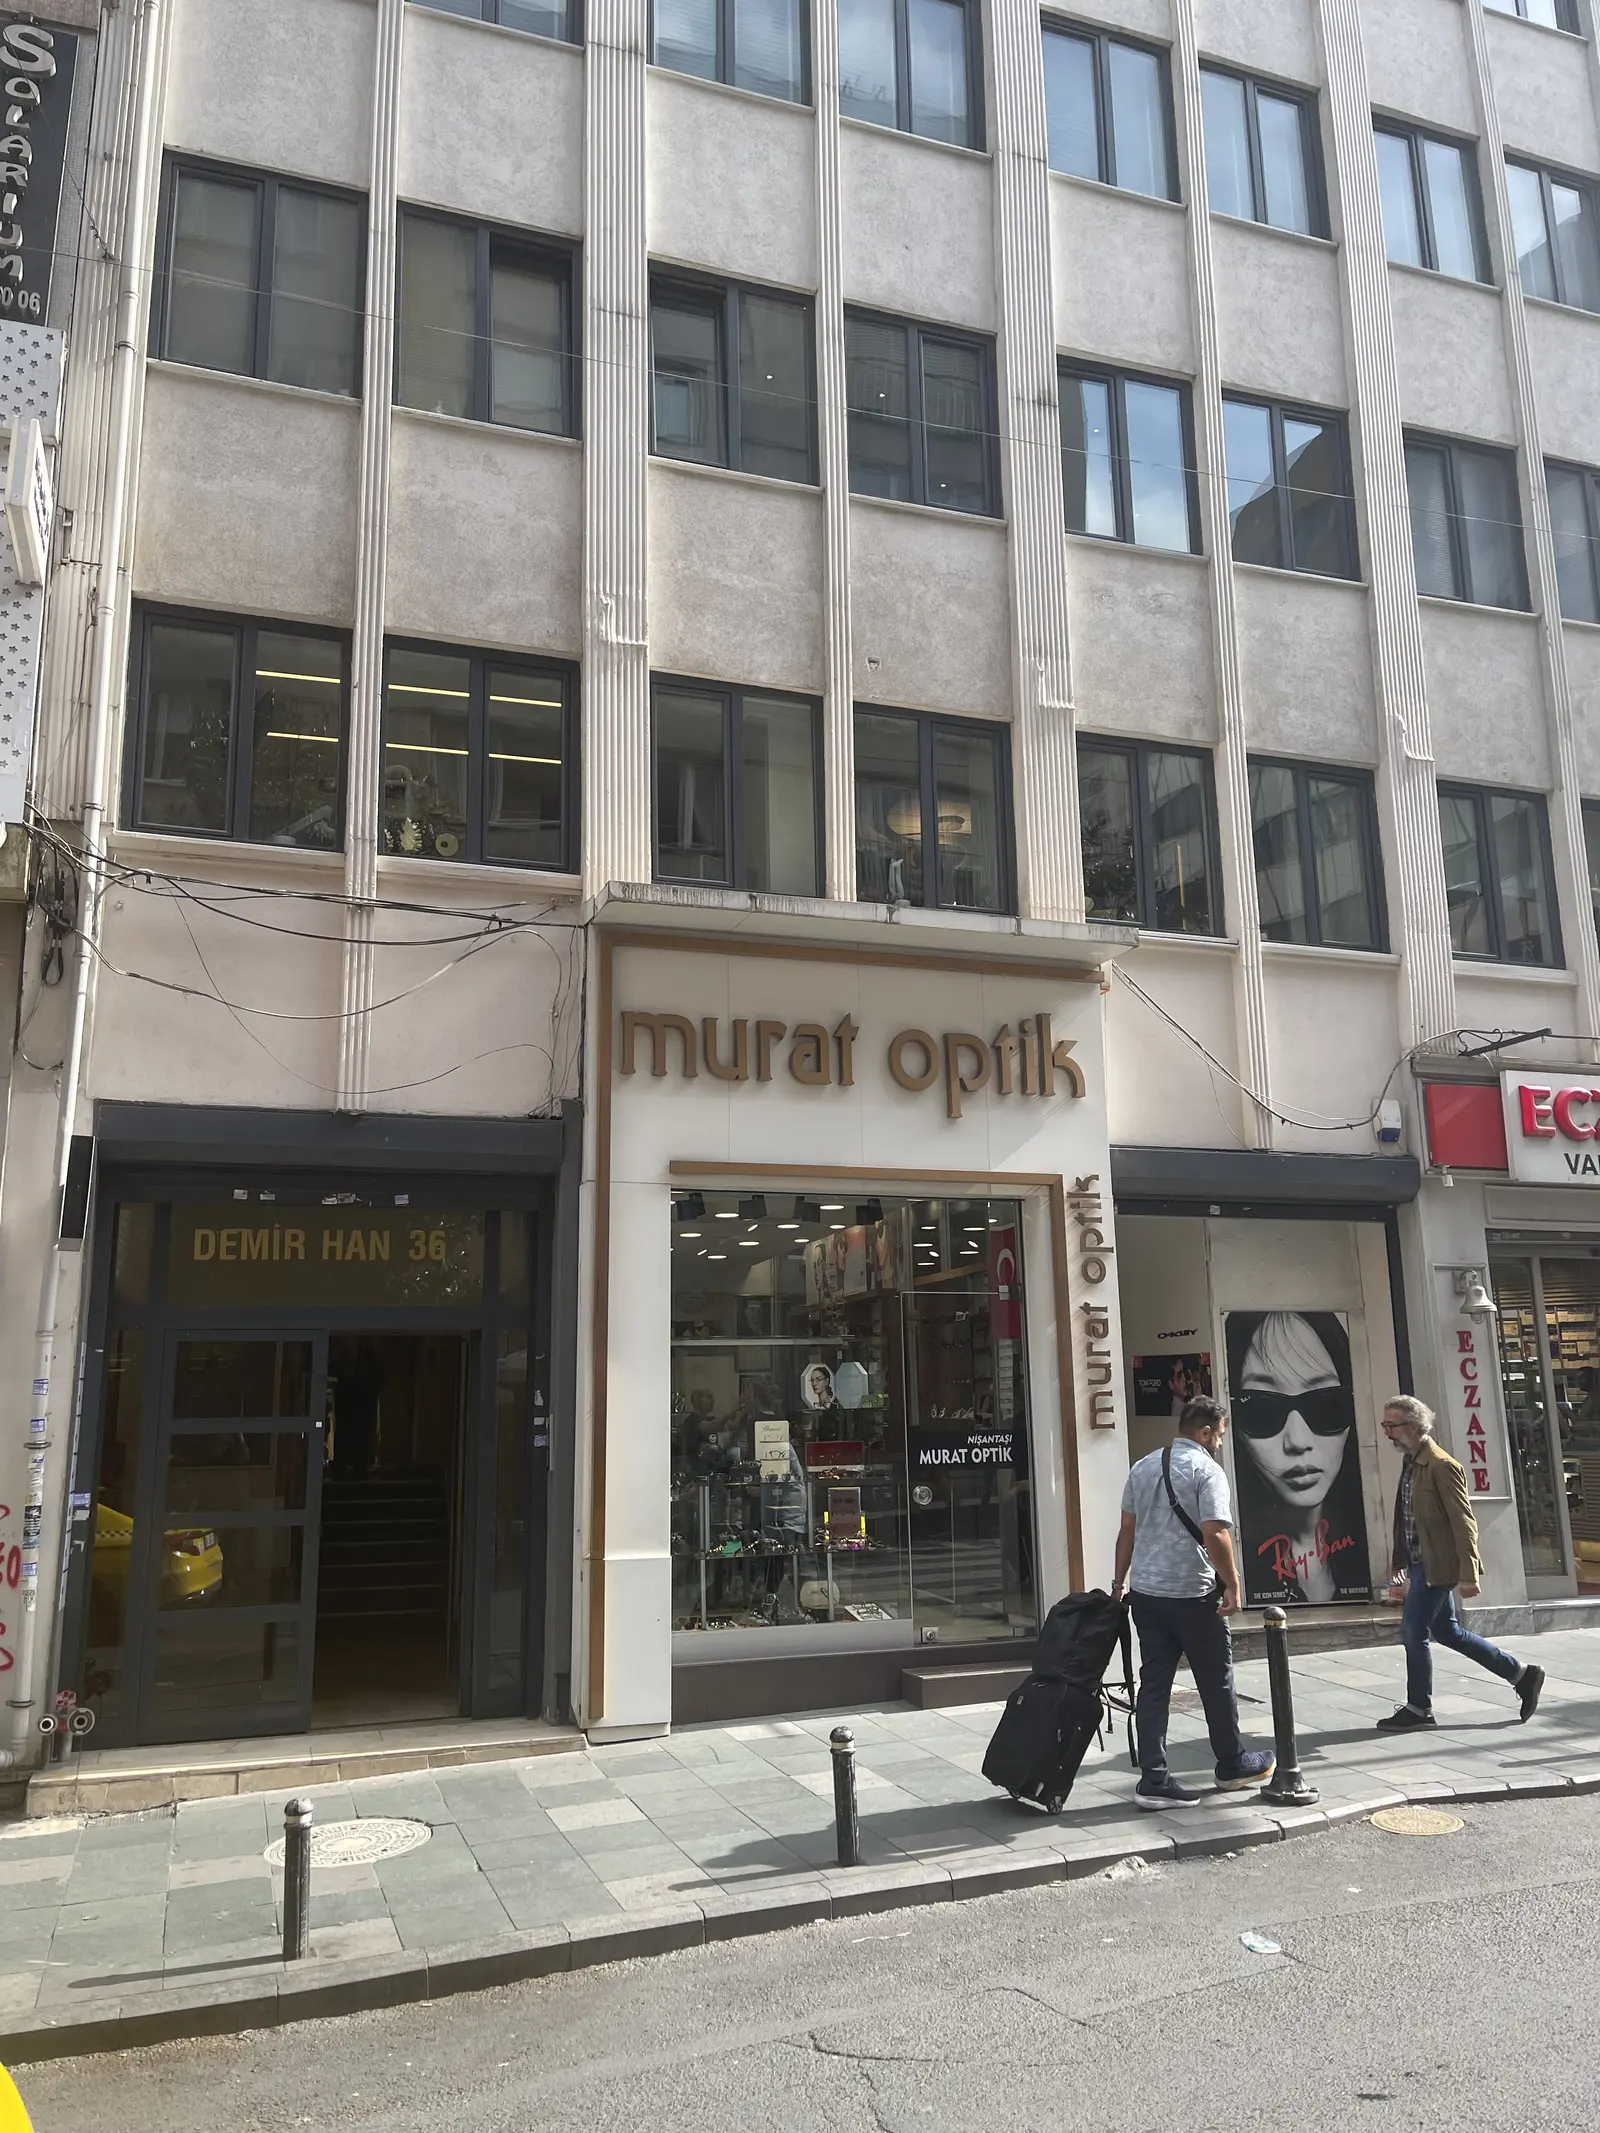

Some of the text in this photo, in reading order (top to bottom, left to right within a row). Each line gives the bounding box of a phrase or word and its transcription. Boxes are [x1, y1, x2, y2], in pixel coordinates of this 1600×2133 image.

[620, 1010, 1086, 1119] murat optik
[1518, 1083, 1600, 1141] EC
[1564, 1153, 1600, 1176] VA
[193, 1222, 447, 1261] DEMİR HAN 36
[1067, 1173, 1116, 1430] murat optik
[1456, 1330, 1491, 1492] ECZANE
[919, 1445, 1013, 1465] MURAT OPTİK
[967, 1433, 1013, 1446] NİŞANTAŞI
